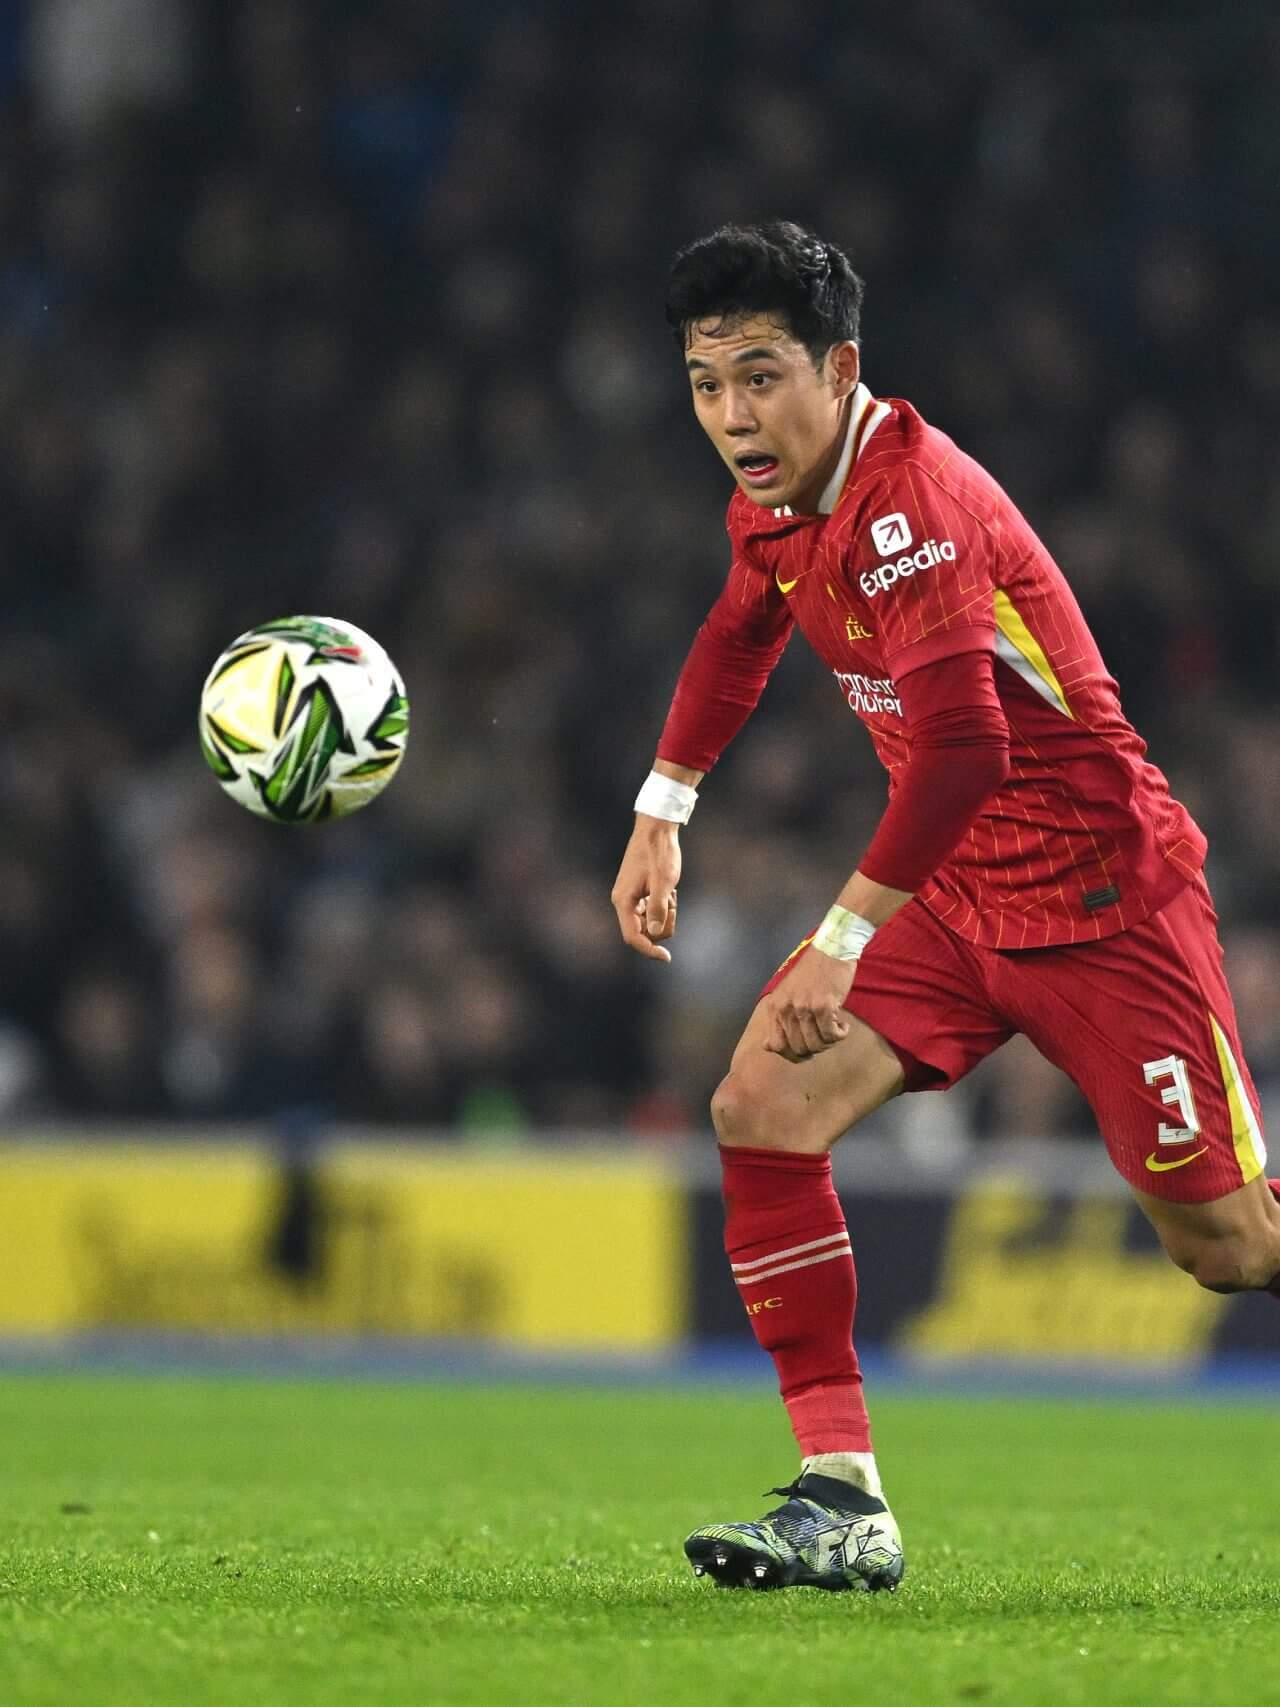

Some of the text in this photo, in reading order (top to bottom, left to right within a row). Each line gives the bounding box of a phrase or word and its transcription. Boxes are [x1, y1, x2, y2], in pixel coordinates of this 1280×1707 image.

[860, 539, 957, 598] Expedia
[1142, 1054, 1201, 1146] 3
[745, 1296, 784, 1316] LFC
